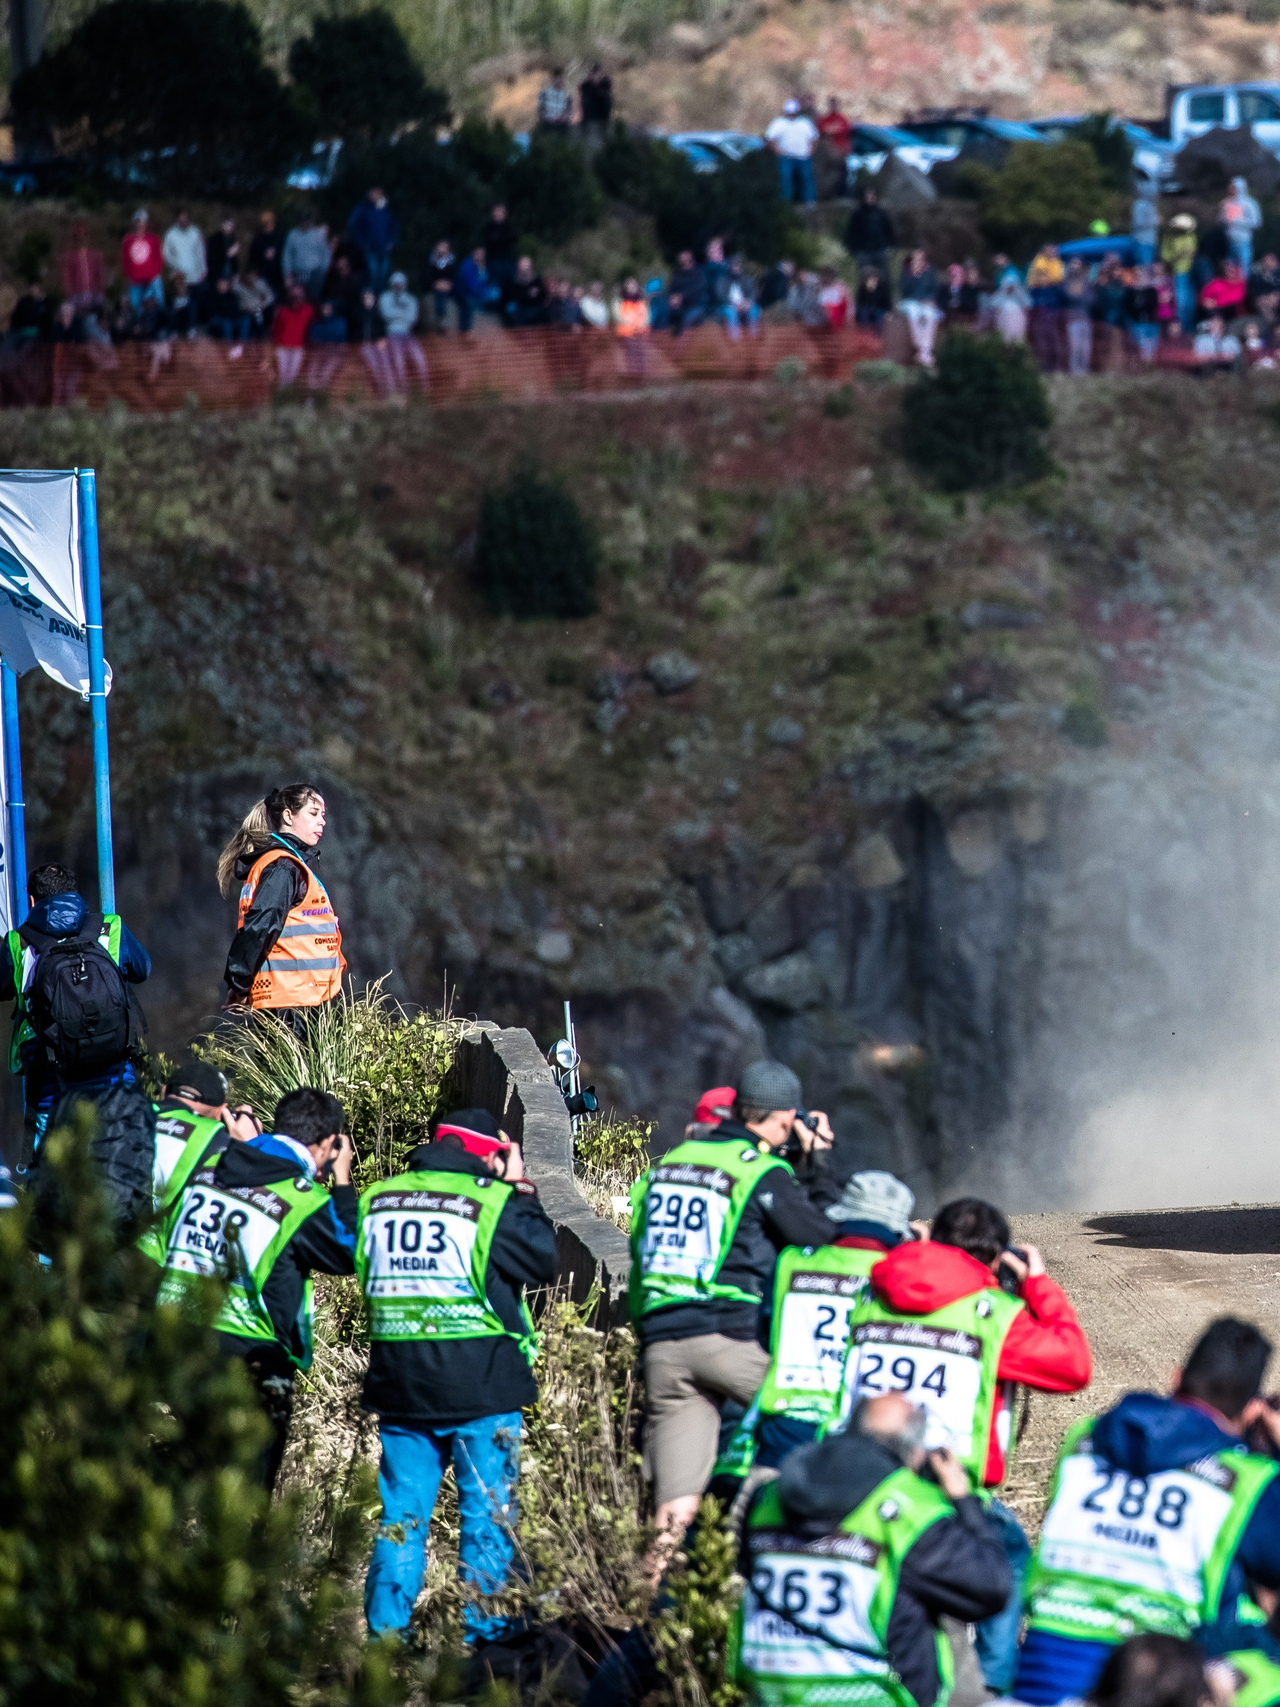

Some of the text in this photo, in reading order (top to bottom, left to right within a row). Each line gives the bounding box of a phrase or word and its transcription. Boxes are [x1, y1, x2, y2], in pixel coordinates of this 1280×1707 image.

[649, 1193, 706, 1231] 298
[384, 1219, 447, 1254] 103
[390, 1256, 439, 1271] MEDIA
[860, 1354, 948, 1398] 294
[1082, 1471, 1189, 1530] 288
